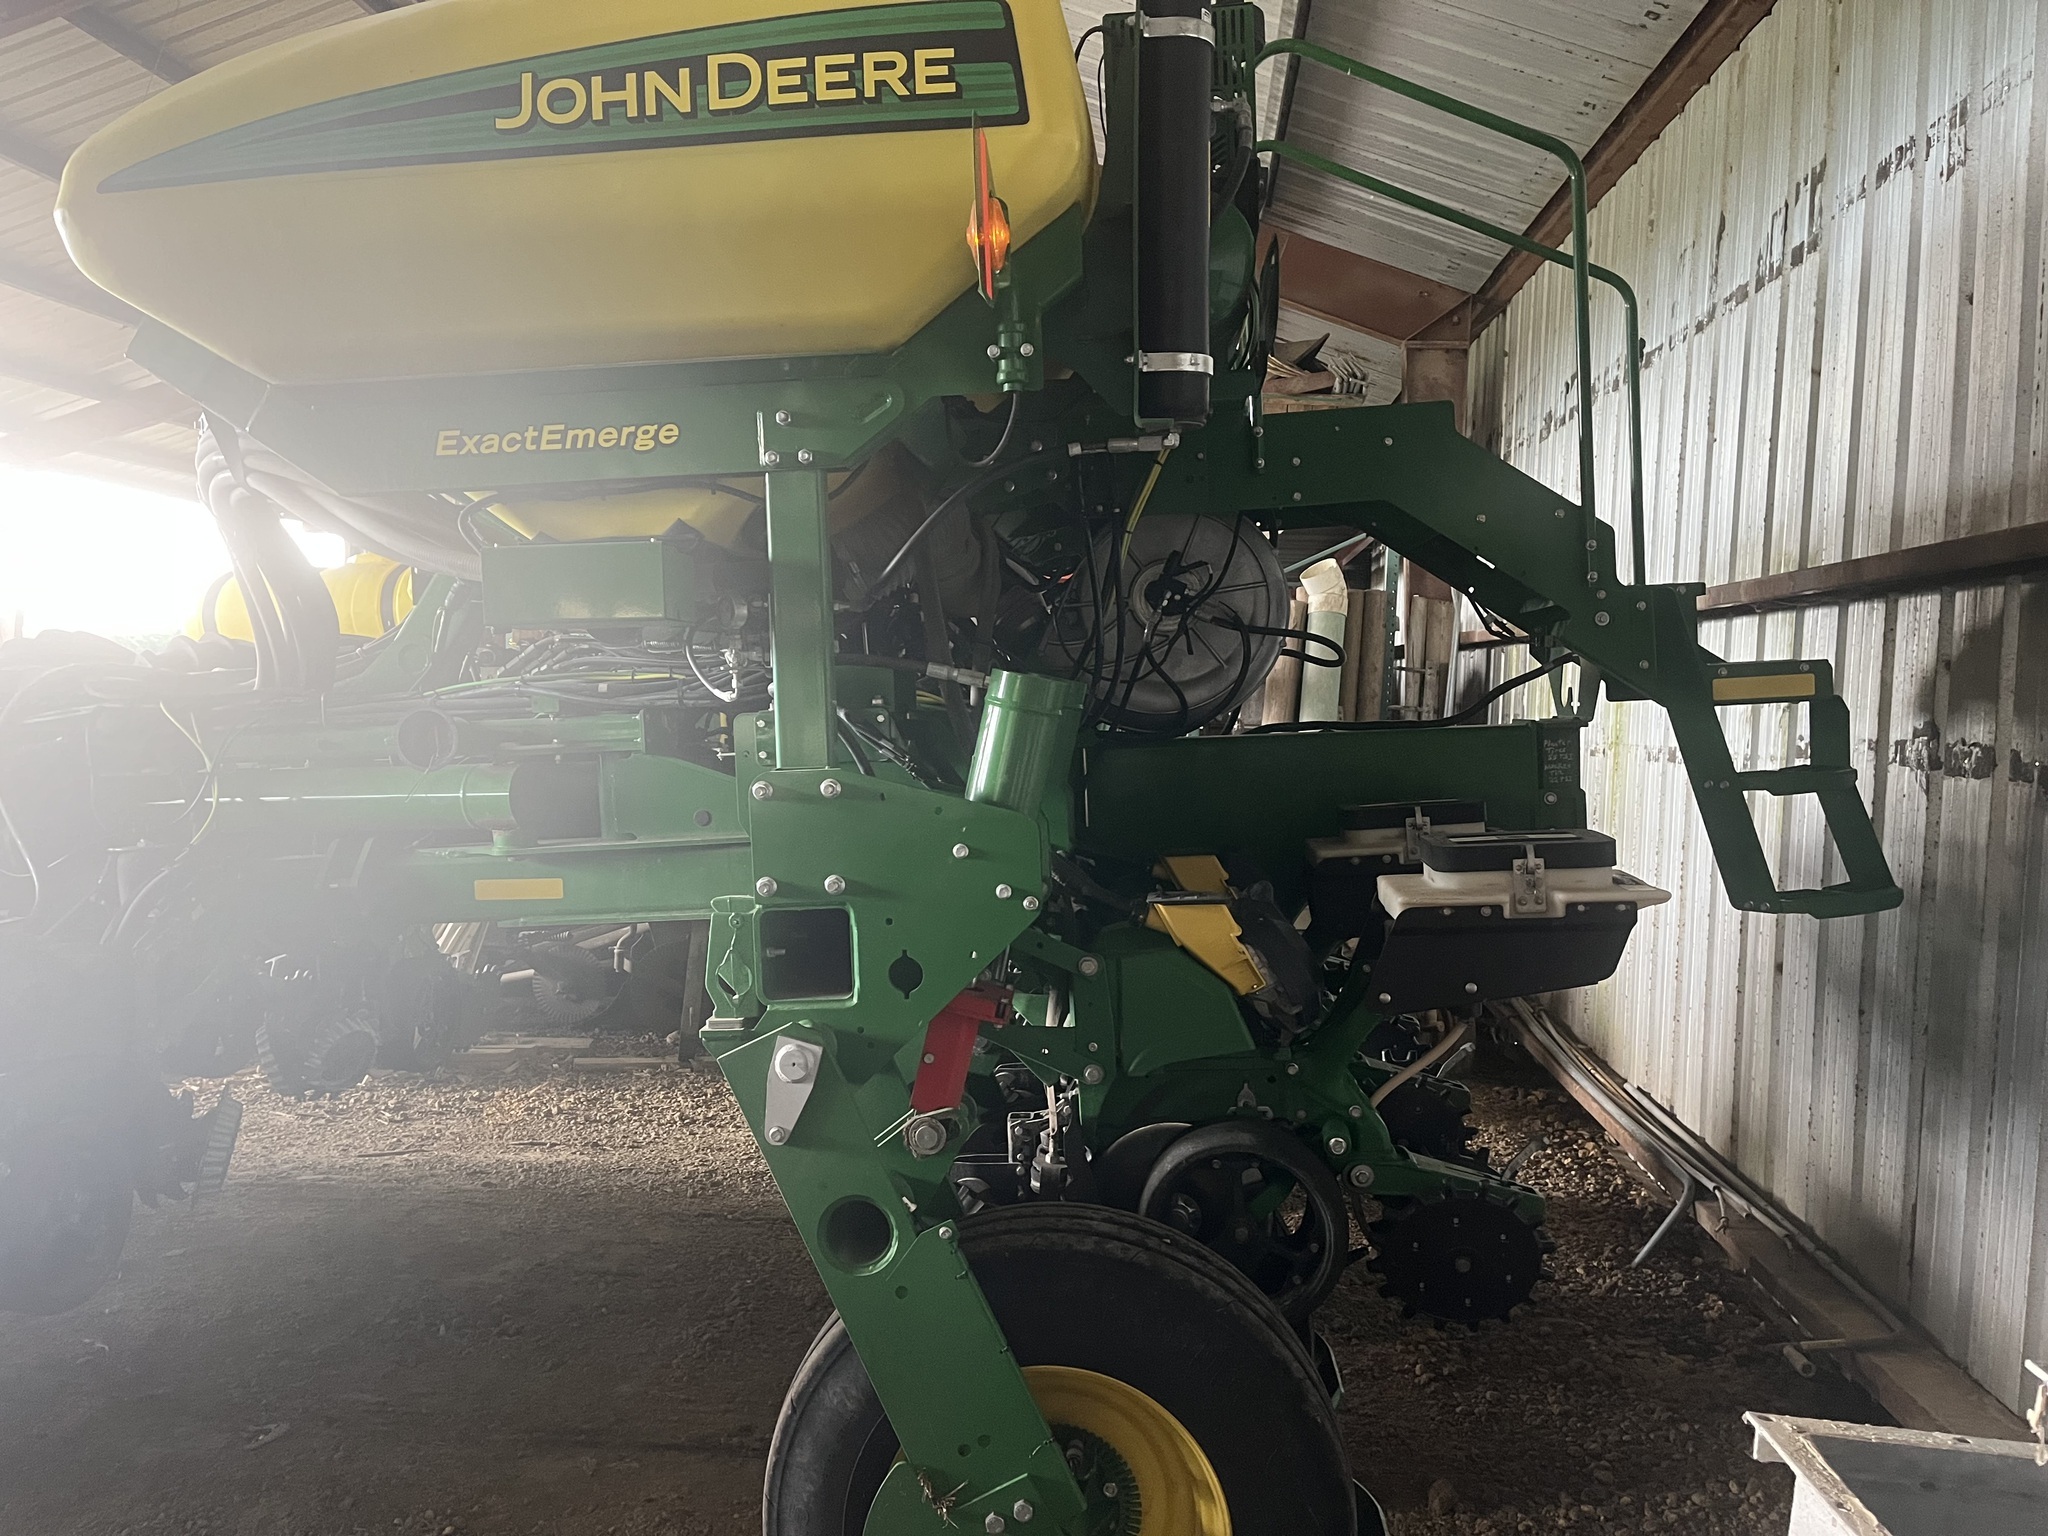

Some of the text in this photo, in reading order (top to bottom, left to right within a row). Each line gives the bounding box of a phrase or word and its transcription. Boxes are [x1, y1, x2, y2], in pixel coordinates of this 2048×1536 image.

[494, 47, 958, 130] JOHN DEERE
[435, 422, 680, 456] ExactEmerge
